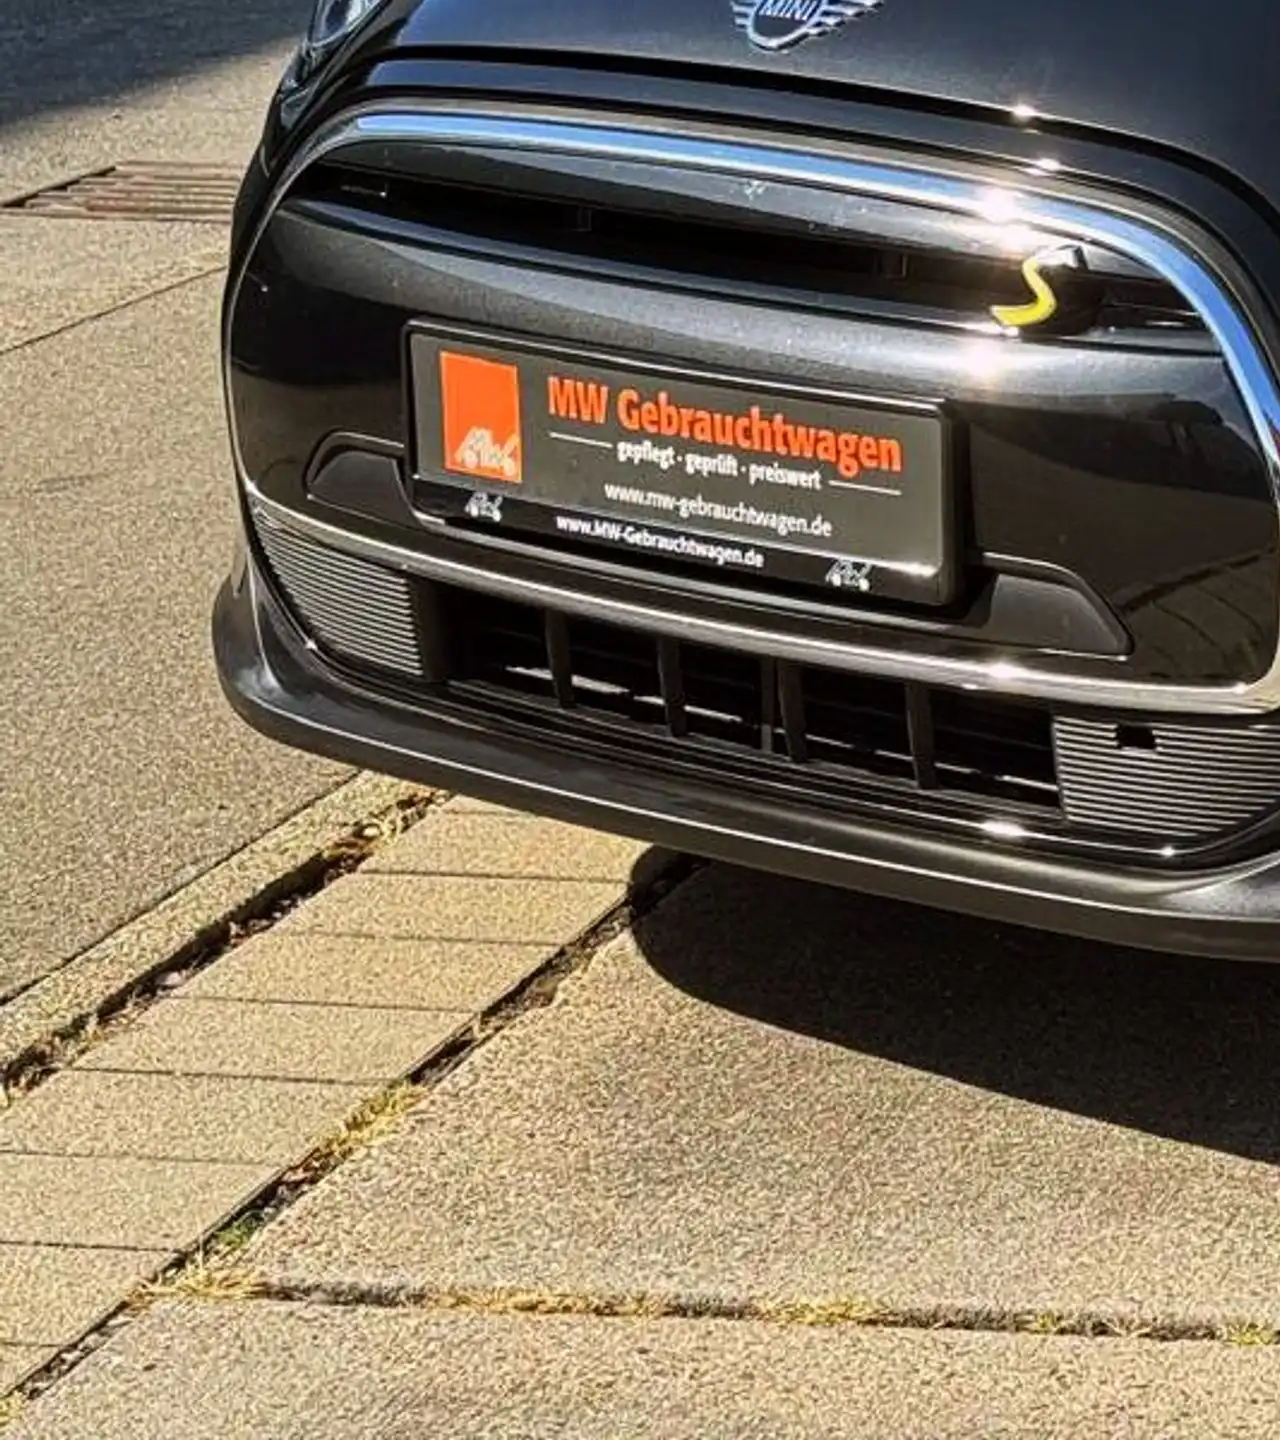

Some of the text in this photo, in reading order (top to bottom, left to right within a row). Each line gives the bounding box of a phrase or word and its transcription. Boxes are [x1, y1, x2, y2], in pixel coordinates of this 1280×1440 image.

[548, 376, 902, 478] MW Gebrauchtwagen
[617, 440, 822, 490] gepflegt geprüft preiswert
[604, 483, 832, 536] www.mw-gebrauchtwagen.de
[556, 516, 765, 568] www.MW-Gebrauchtwagen.de
